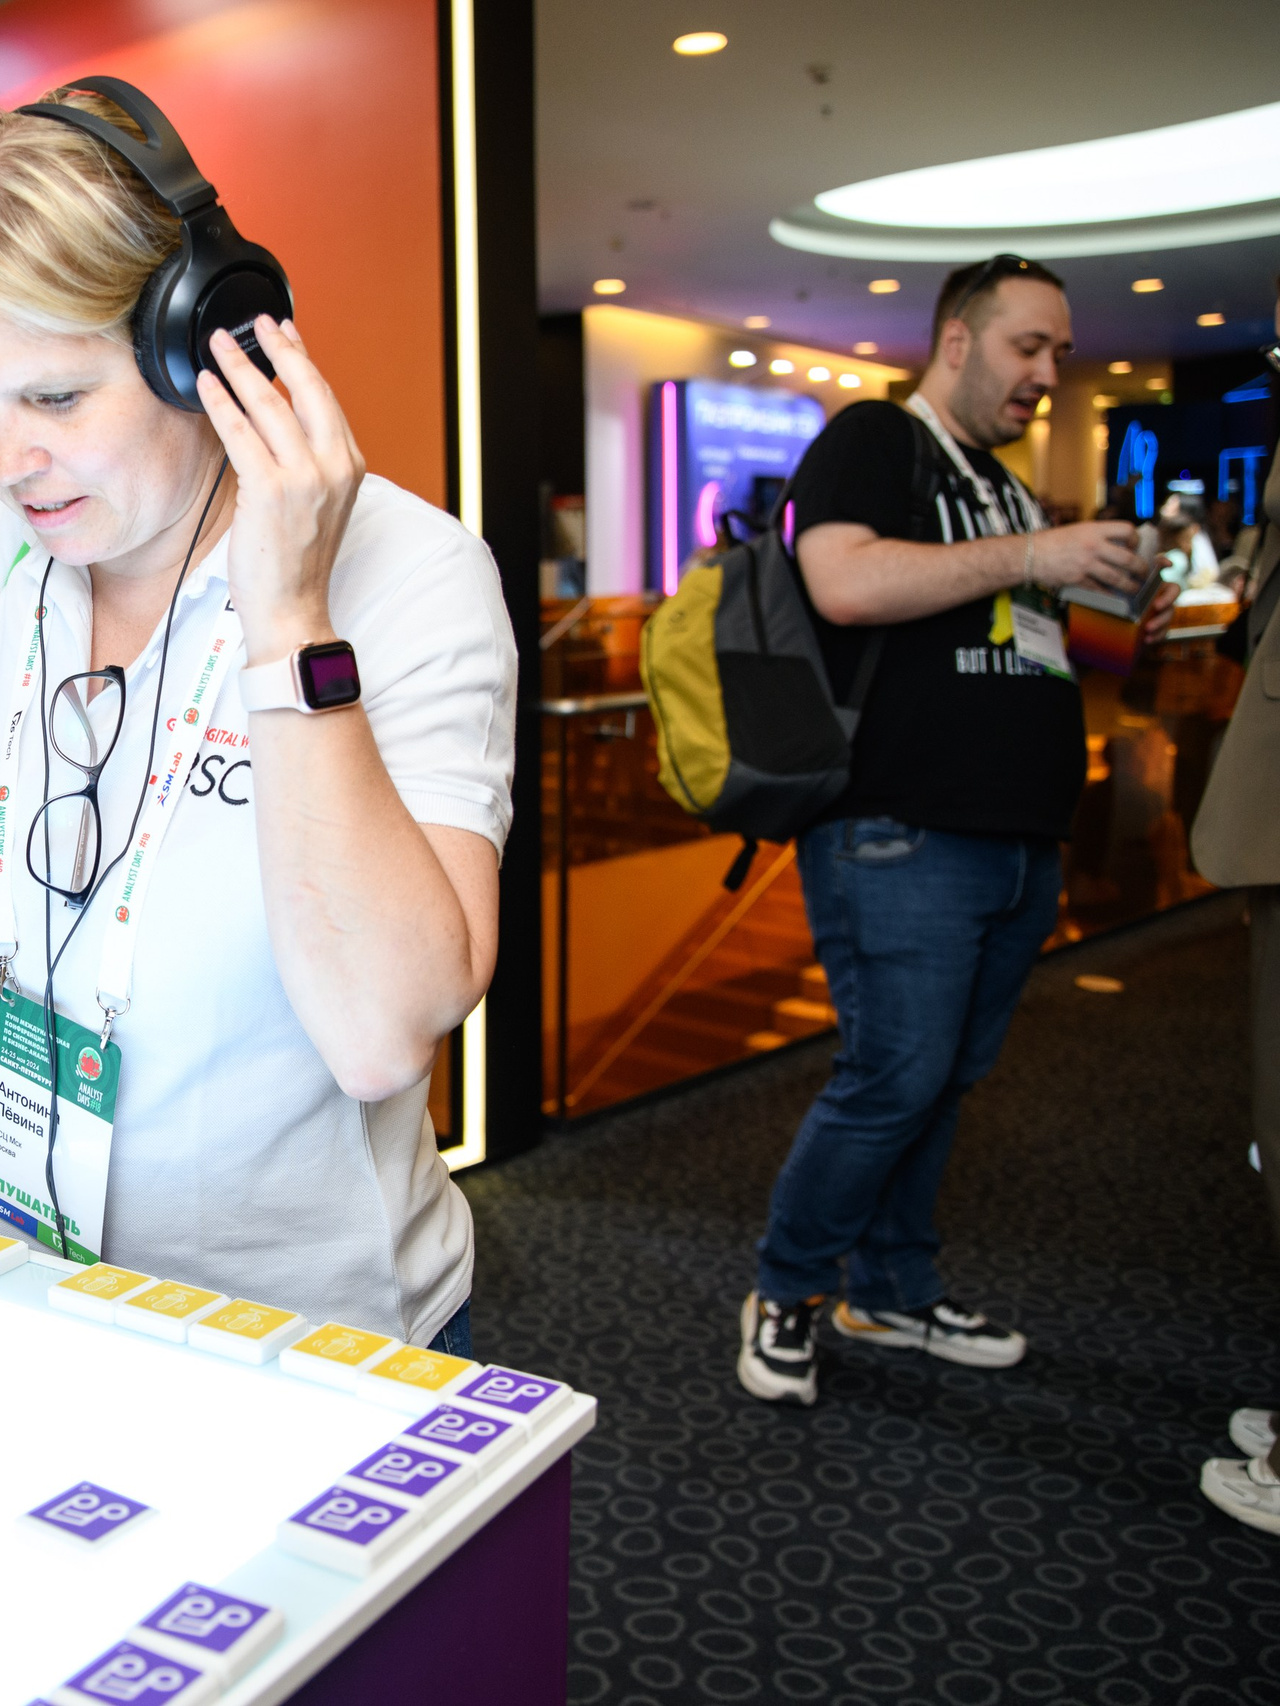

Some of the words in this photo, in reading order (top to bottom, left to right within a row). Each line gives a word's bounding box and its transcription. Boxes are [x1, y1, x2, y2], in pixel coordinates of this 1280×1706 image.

[25, 654, 36, 671] DAYS
[192, 672, 211, 704] ANALYST
[204, 654, 219, 672] DAYS
[212, 638, 226, 653] #18
[21, 673, 31, 687] #18
[203, 724, 237, 747] IGITAL
[162, 773, 175, 792] SM
[169, 751, 183, 775] Lab
[184, 752, 252, 806] SC
[122, 868, 138, 902] ANALYST
[131, 849, 144, 868] DAYS
[138, 832, 151, 848] #18
[3, 1027, 12, 1036] ПО
[12, 1032, 49, 1055] СИСТЕМНОМУ
[4, 1019, 45, 1045] КОНФЕРЕНЦИЯ
[20, 1018, 70, 1049] МЕЖДУНДНАЯ
[1, 1046, 17, 1059] 24-25
[26, 1059, 40, 1071] 2024
[7, 1037, 50, 1065] БИЗНЕС-АНАЛИ
[78, 1082, 104, 1103] ANALYST
[0, 1205, 11, 1217] SM
[67, 1246, 86, 1263] Tech
